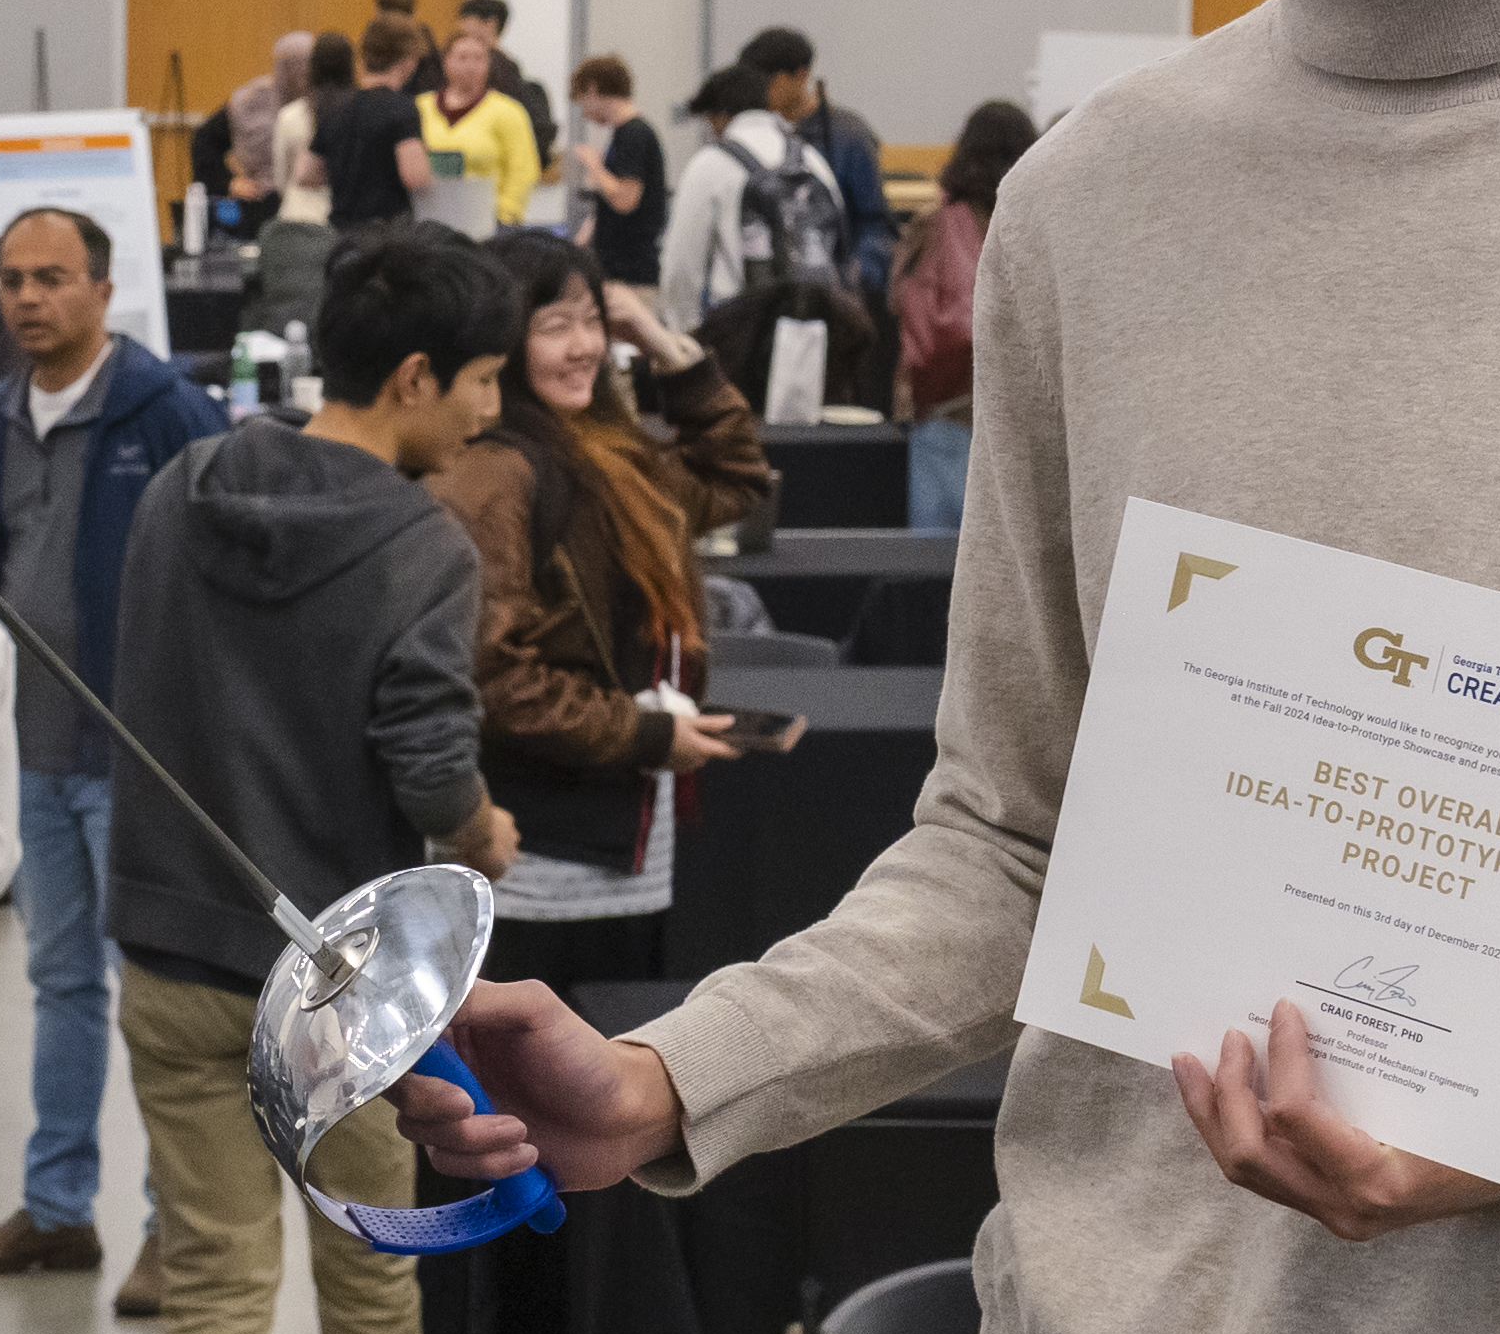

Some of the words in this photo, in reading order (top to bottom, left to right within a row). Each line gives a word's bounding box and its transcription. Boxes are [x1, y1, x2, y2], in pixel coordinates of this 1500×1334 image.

[1353, 627, 1430, 688] GT
[1452, 654, 1493, 674] Georgia
[1183, 661, 1203, 676] The
[1204, 667, 1244, 687] Georgia
[1245, 679, 1290, 699] Institute
[1290, 692, 1304, 703] of
[1306, 694, 1365, 722] Technology
[1366, 714, 1399, 730] would
[1399, 721, 1418, 736] like
[1420, 728, 1432, 739] to
[1433, 732, 1485, 755] recognize
[1230, 693, 1242, 703] at
[1243, 695, 1261, 709] the
[1262, 699, 1283, 714] Fall
[1283, 705, 1310, 722] 2024
[1312, 714, 1401, 748] Idea-to-Prototype
[1402, 739, 1457, 764] Showcase
[1457, 757, 1479, 770] and
[1313, 760, 1390, 800] BEST
[1341, 841, 1476, 900] PROJECT
[1283, 883, 1336, 908] Presented
[1337, 901, 1351, 912] on
[1352, 905, 1372, 919] this
[1373, 910, 1393, 925] 3rd
[1393, 917, 1413, 933] day
[1413, 924, 1427, 935] of
[1427, 927, 1480, 952] December
[1320, 1001, 1354, 1021] CRAIG
[1354, 1013, 1398, 1037] FOREST,
[1400, 1027, 1424, 1044] PHD
[1346, 1029, 1389, 1050] Professor
[1247, 1012, 1274, 1029] Geor
[1303, 1028, 1336, 1047] odruff
[1336, 1040, 1367, 1057] School
[1366, 1052, 1378, 1061] of
[1377, 1054, 1428, 1078] Mechanical
[1428, 1071, 1480, 1098] Engineering
[1328, 1053, 1365, 1072] Institute
[1365, 1066, 1377, 1075] of
[1378, 1068, 1427, 1094] Technology
